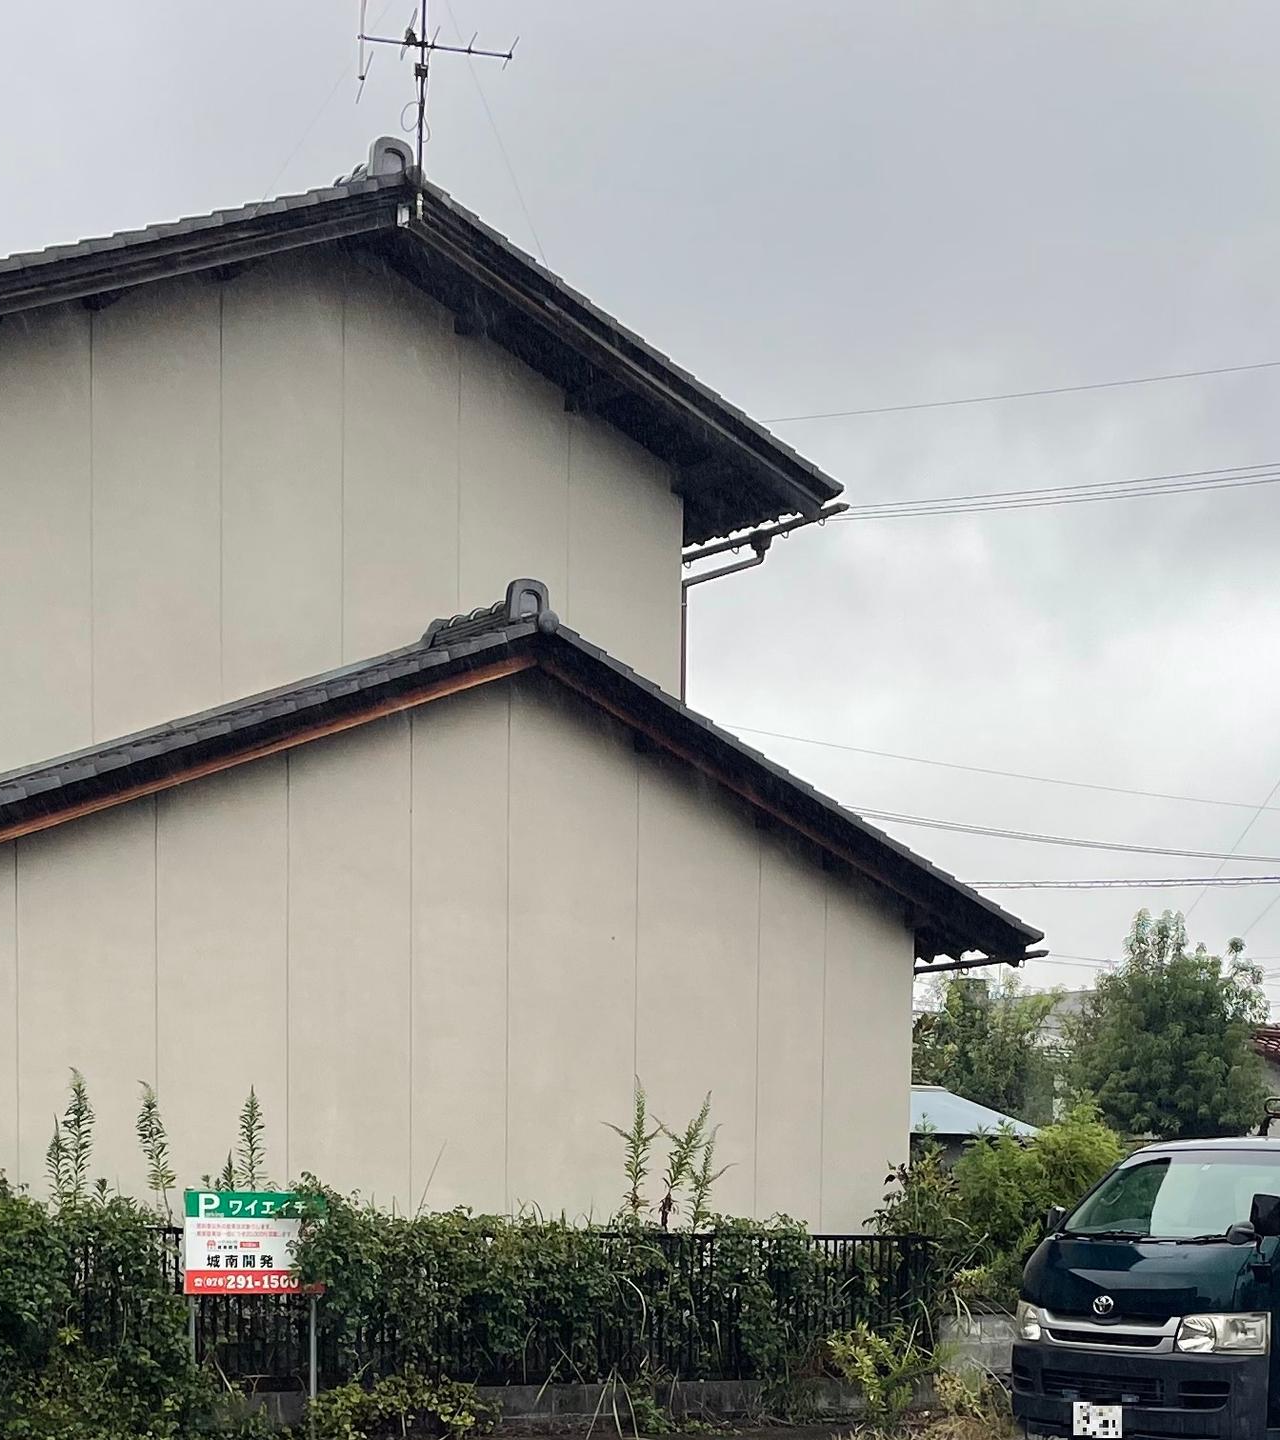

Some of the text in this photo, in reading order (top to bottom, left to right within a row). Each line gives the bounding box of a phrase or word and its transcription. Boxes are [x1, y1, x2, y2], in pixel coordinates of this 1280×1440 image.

[199, 1193, 220, 1218] P
[206, 1254, 273, 1268] 城南開発
